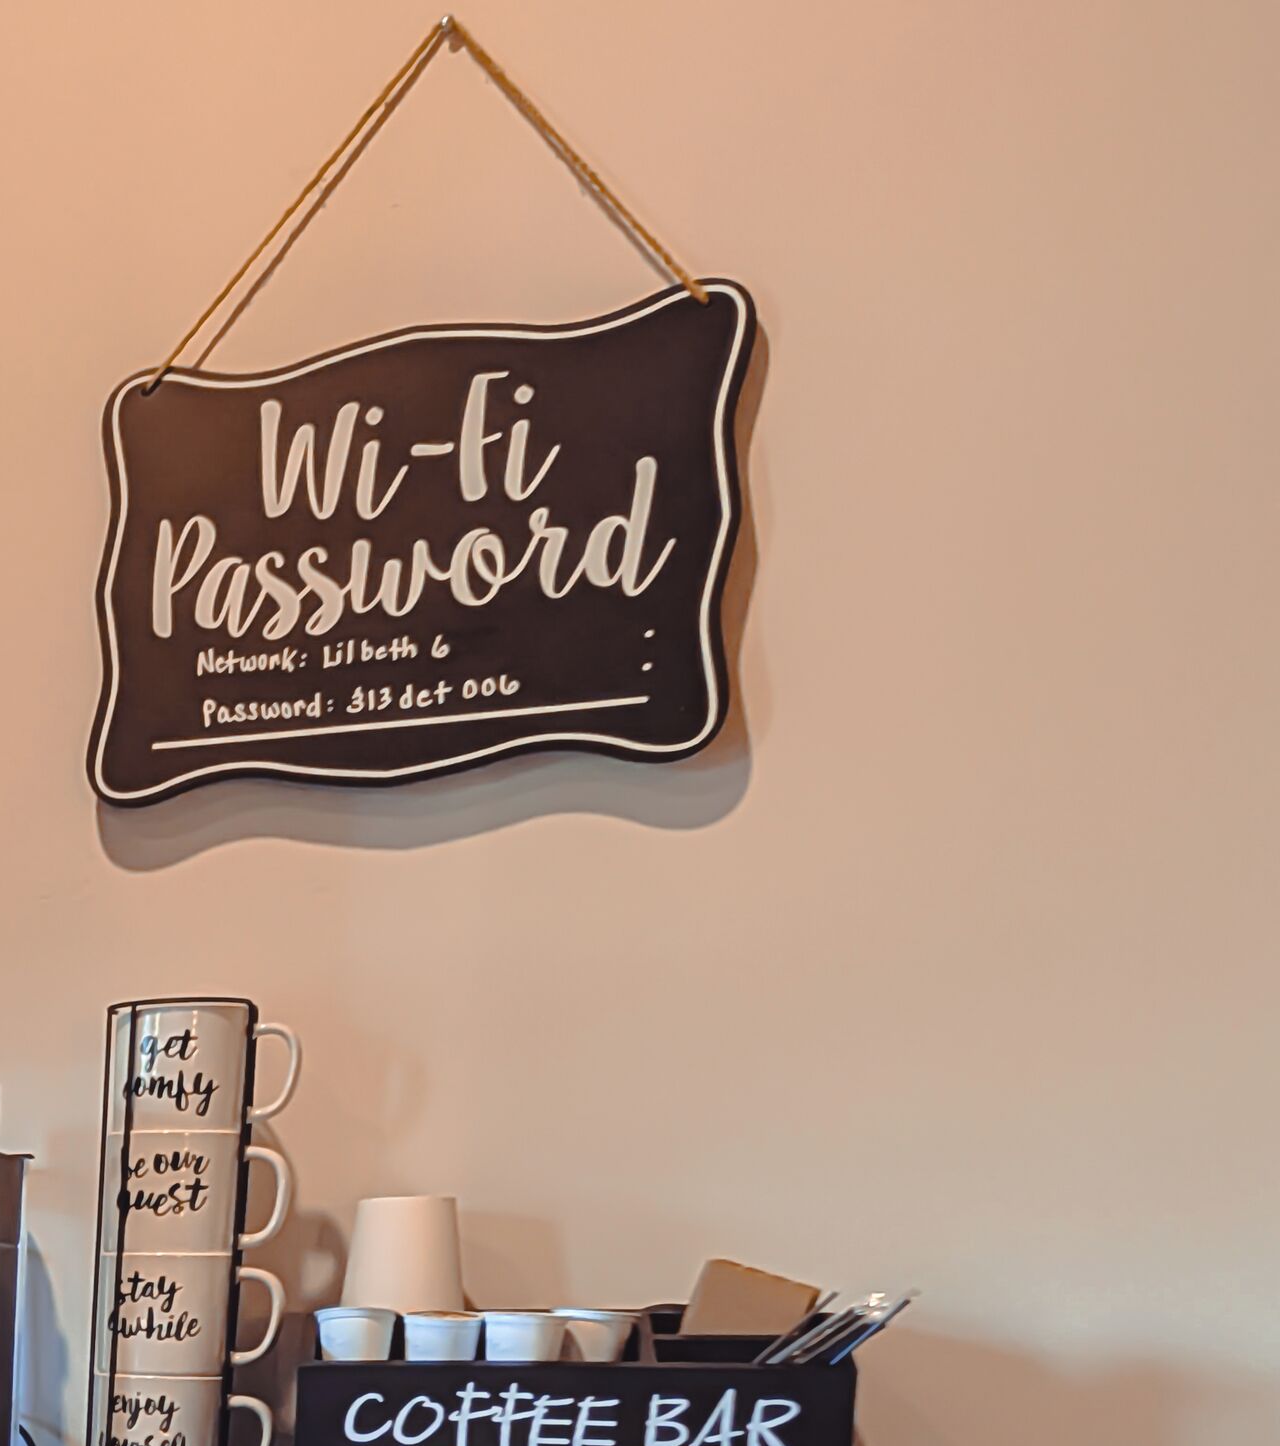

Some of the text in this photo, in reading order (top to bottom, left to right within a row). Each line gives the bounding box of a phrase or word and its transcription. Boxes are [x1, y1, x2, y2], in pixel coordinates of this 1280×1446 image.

[260, 370, 562, 520] Wi-Fi
[151, 455, 677, 641] Password
[196, 646, 309, 677] Network:
[202, 691, 335, 728] Password:
[139, 1028, 199, 1073] get
[152, 1150, 211, 1176] our
